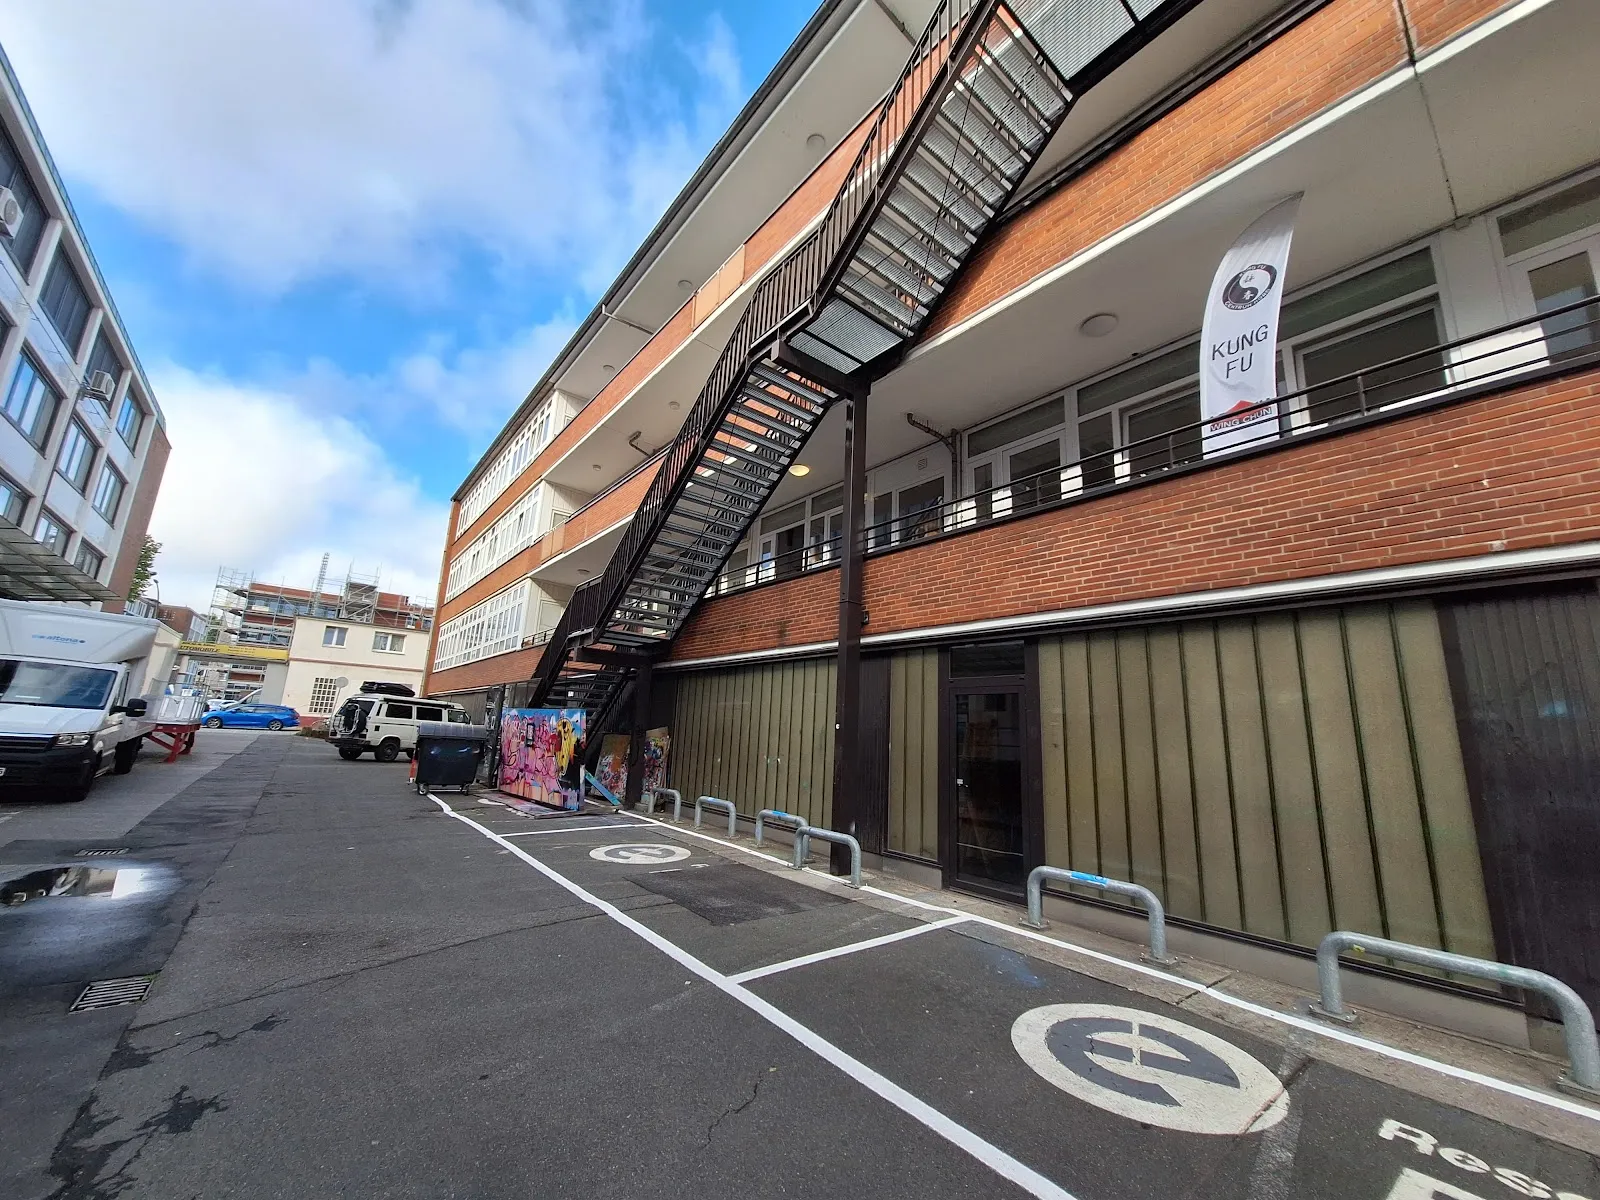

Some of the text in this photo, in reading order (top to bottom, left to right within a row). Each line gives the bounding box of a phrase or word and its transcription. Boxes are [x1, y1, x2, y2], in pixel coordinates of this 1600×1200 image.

[1212, 324, 1269, 361] KUNG
[1226, 352, 1253, 379] FU
[1210, 418, 1240, 431] WING
[1242, 407, 1272, 423] CHUN
[1378, 1118, 1593, 1200] Res
